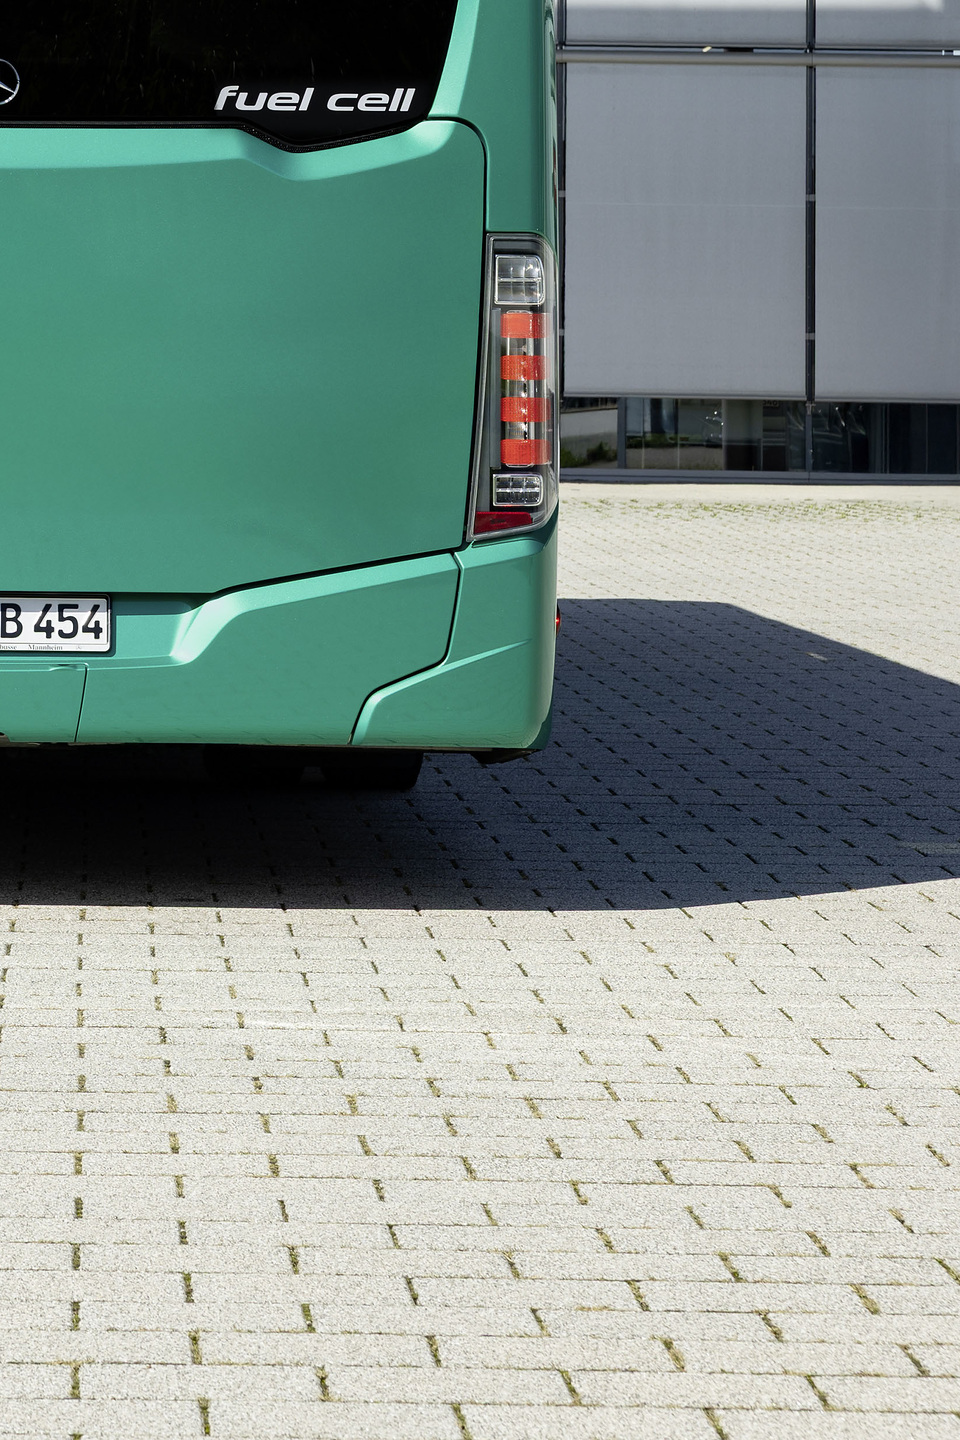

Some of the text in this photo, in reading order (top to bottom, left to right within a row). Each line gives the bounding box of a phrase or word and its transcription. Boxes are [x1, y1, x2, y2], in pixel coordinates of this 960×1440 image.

[213, 85, 416, 112] fuel cell
[33, 603, 104, 640] 454
